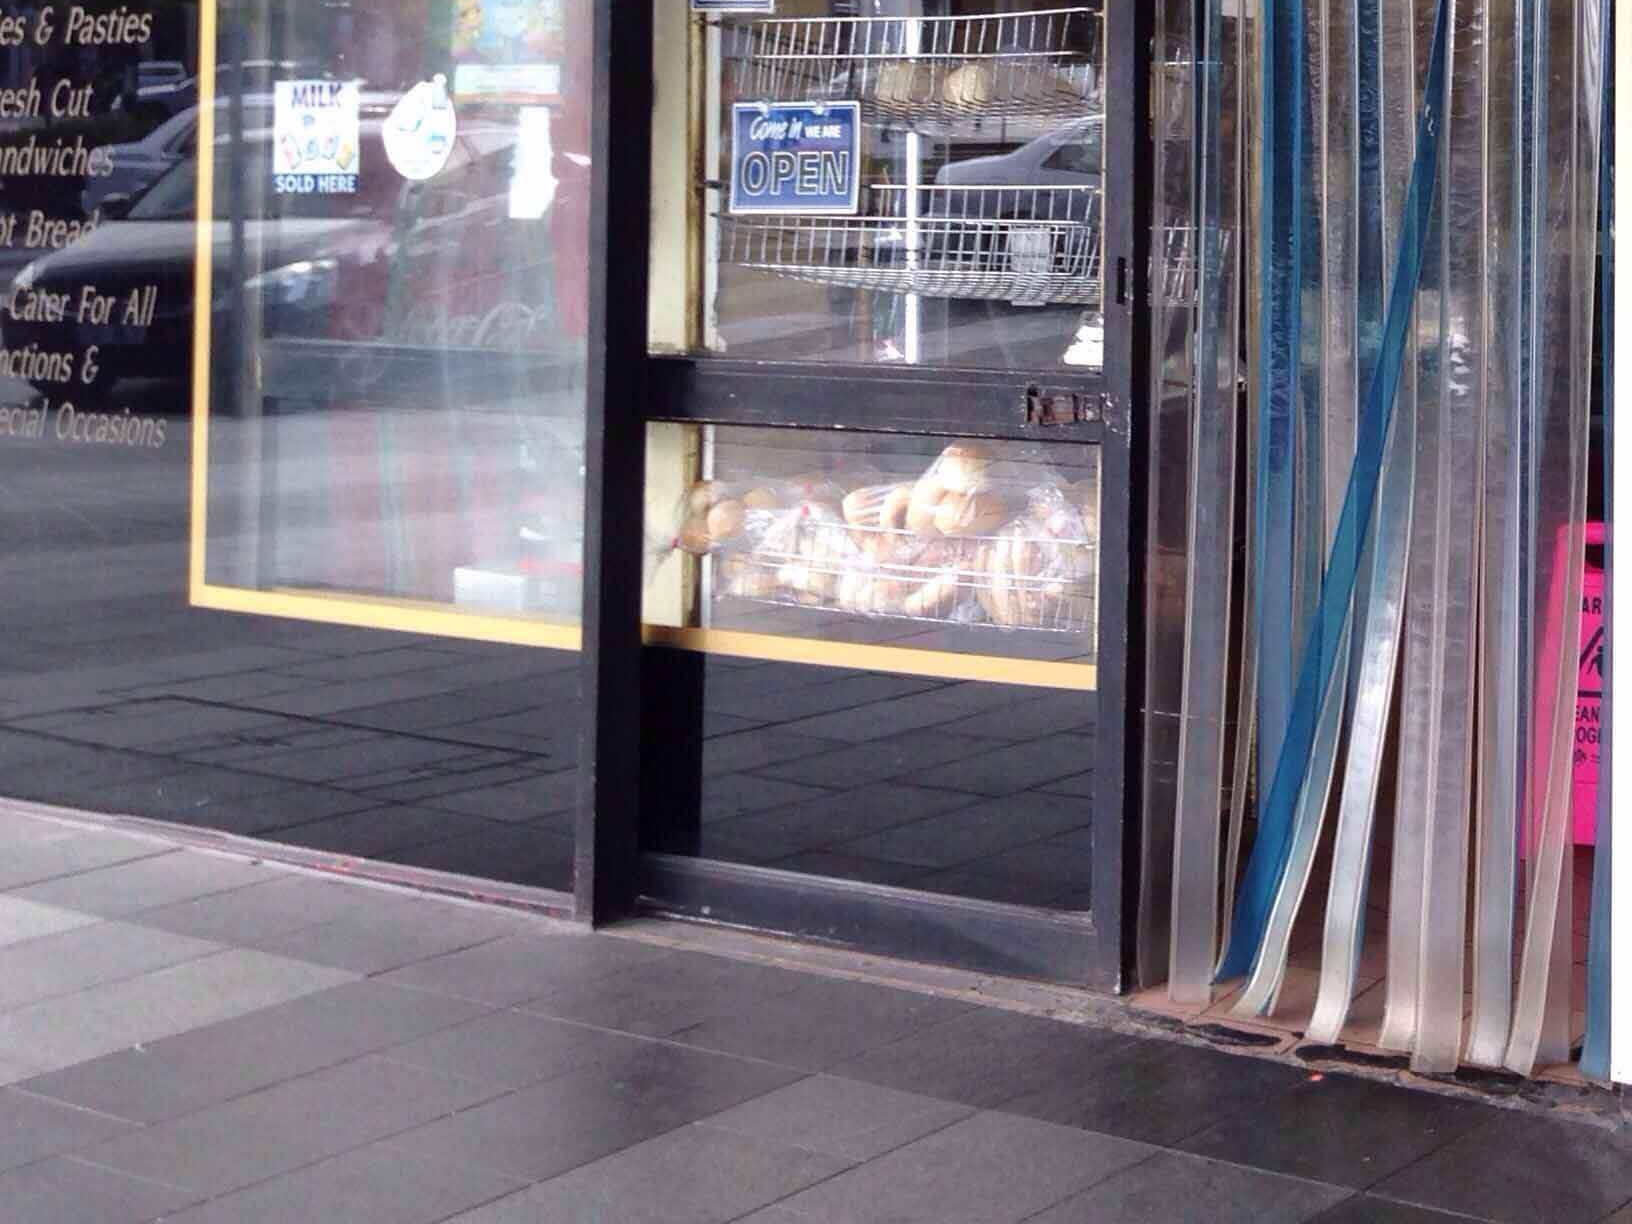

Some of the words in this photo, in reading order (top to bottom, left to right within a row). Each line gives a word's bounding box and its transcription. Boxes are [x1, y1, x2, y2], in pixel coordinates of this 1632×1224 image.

[0, 8, 27, 46] es
[34, 6, 54, 46] &
[64, 6, 153, 45] Pasties
[0, 77, 41, 117] esh
[51, 78, 94, 118] Cut
[291, 83, 342, 108] MILK
[750, 116, 788, 140] Come
[788, 117, 803, 140] in
[805, 125, 822, 138] WE
[823, 125, 842, 138] ARE
[0, 134, 115, 176] ndwiches
[742, 151, 850, 196] OPEN
[275, 176, 316, 193] SOLD
[319, 176, 356, 192] HERE
[25, 209, 100, 249] Bread
[9, 284, 71, 323] Cater
[77, 284, 116, 326] For
[121, 284, 158, 326] All
[81, 344, 99, 385] &
[55, 402, 168, 449] Occasions
